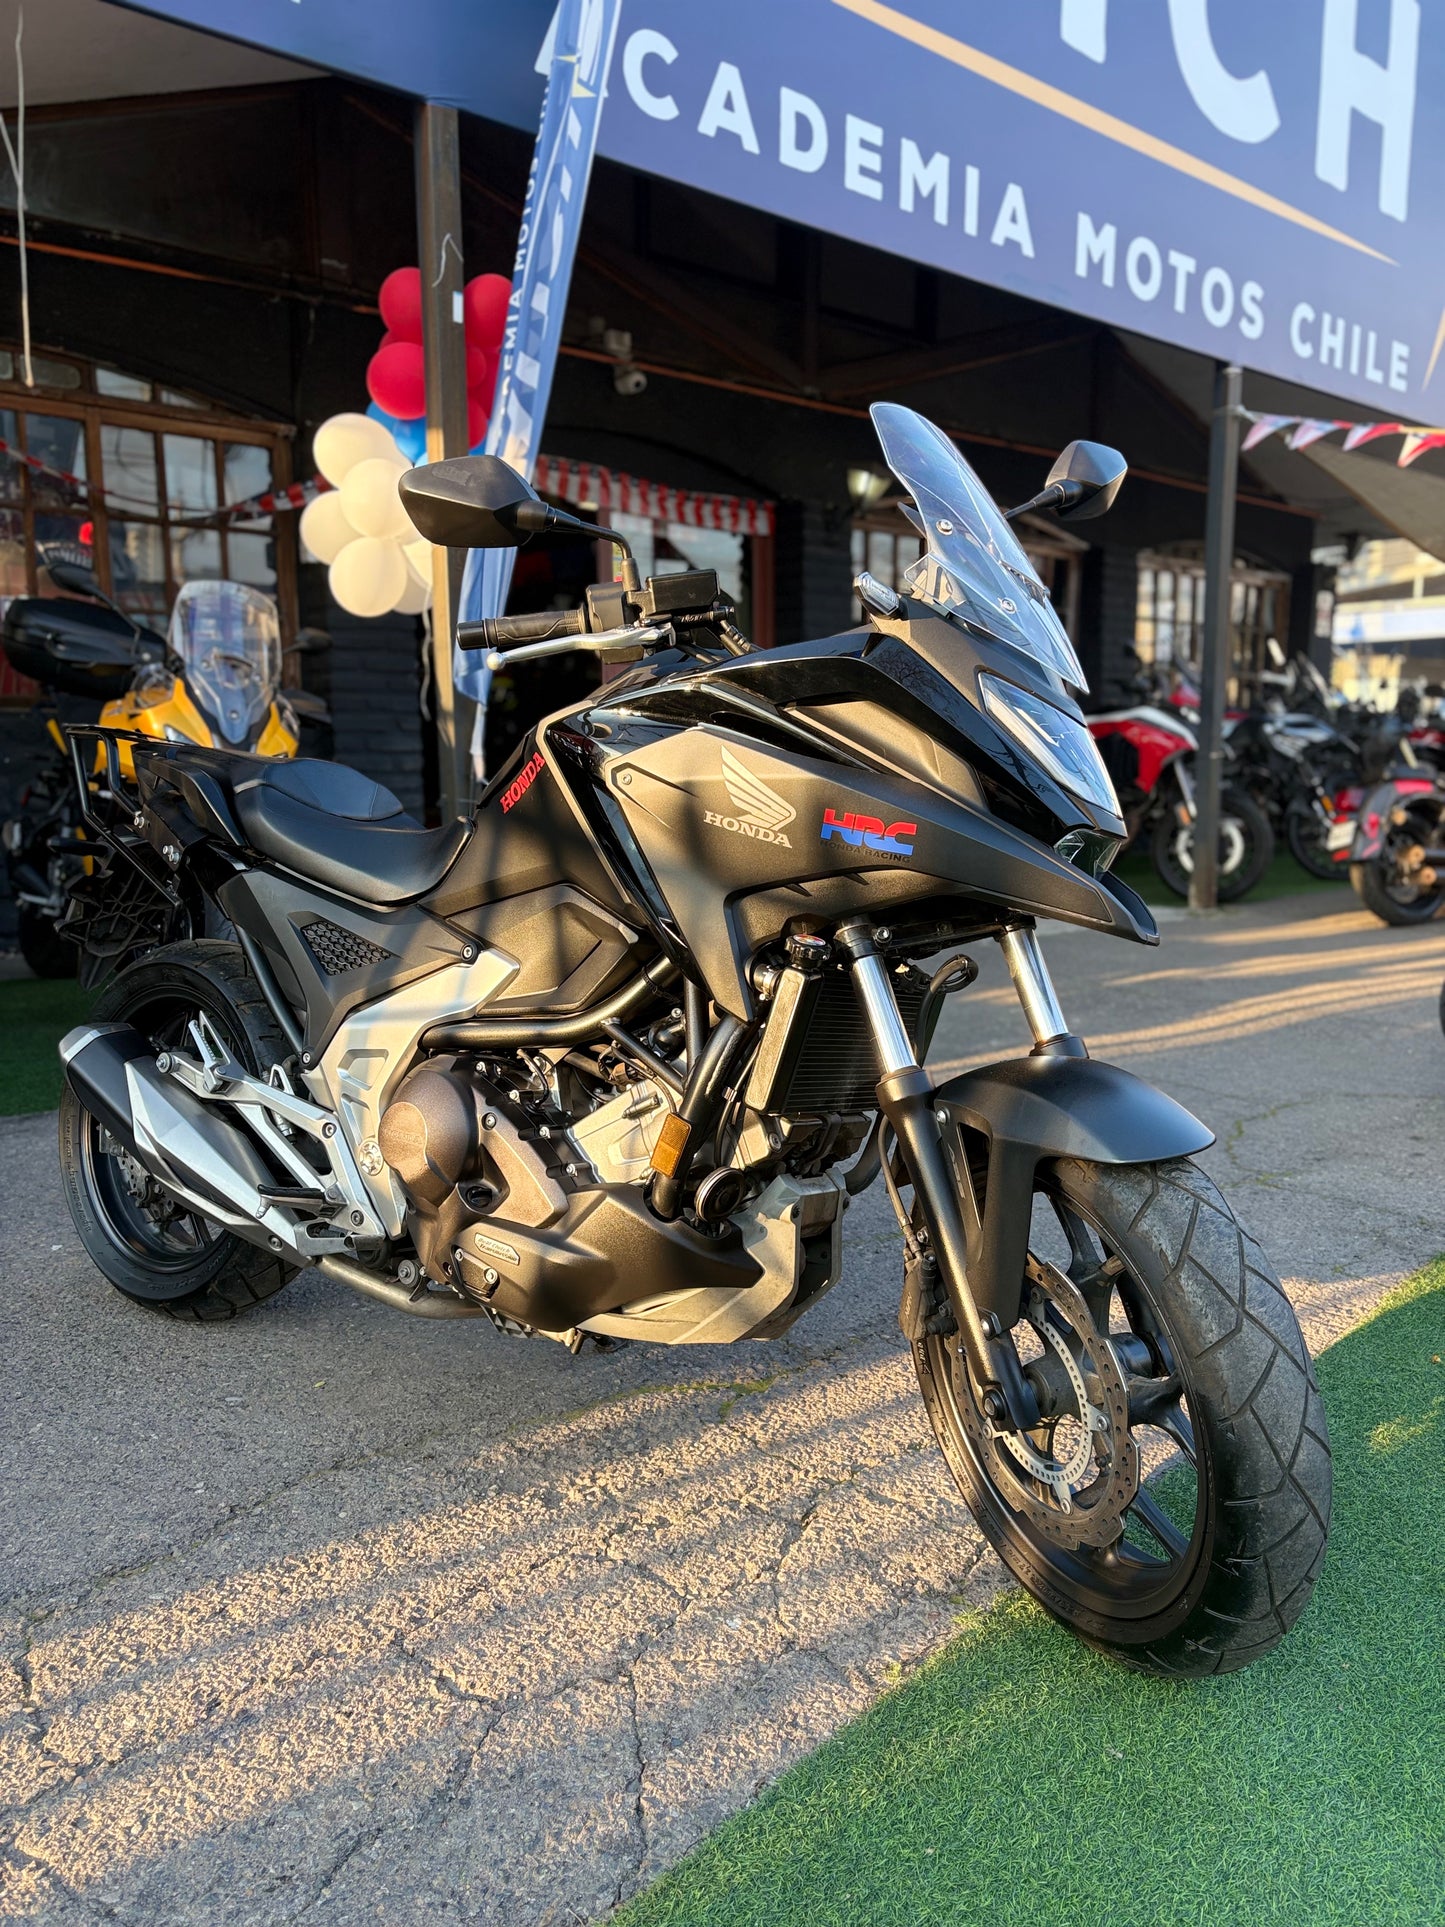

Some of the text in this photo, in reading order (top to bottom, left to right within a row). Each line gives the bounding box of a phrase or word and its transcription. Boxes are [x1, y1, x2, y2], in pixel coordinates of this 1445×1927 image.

[1060, 0, 1420, 222] CH
[1075, 212, 1265, 340] MOTOS
[1291, 302, 1410, 394] CHILE
[499, 751, 546, 814] HONDA
[703, 810, 793, 849] HONDA
[820, 808, 917, 856] HRC
[863, 847, 911, 864] RACING
